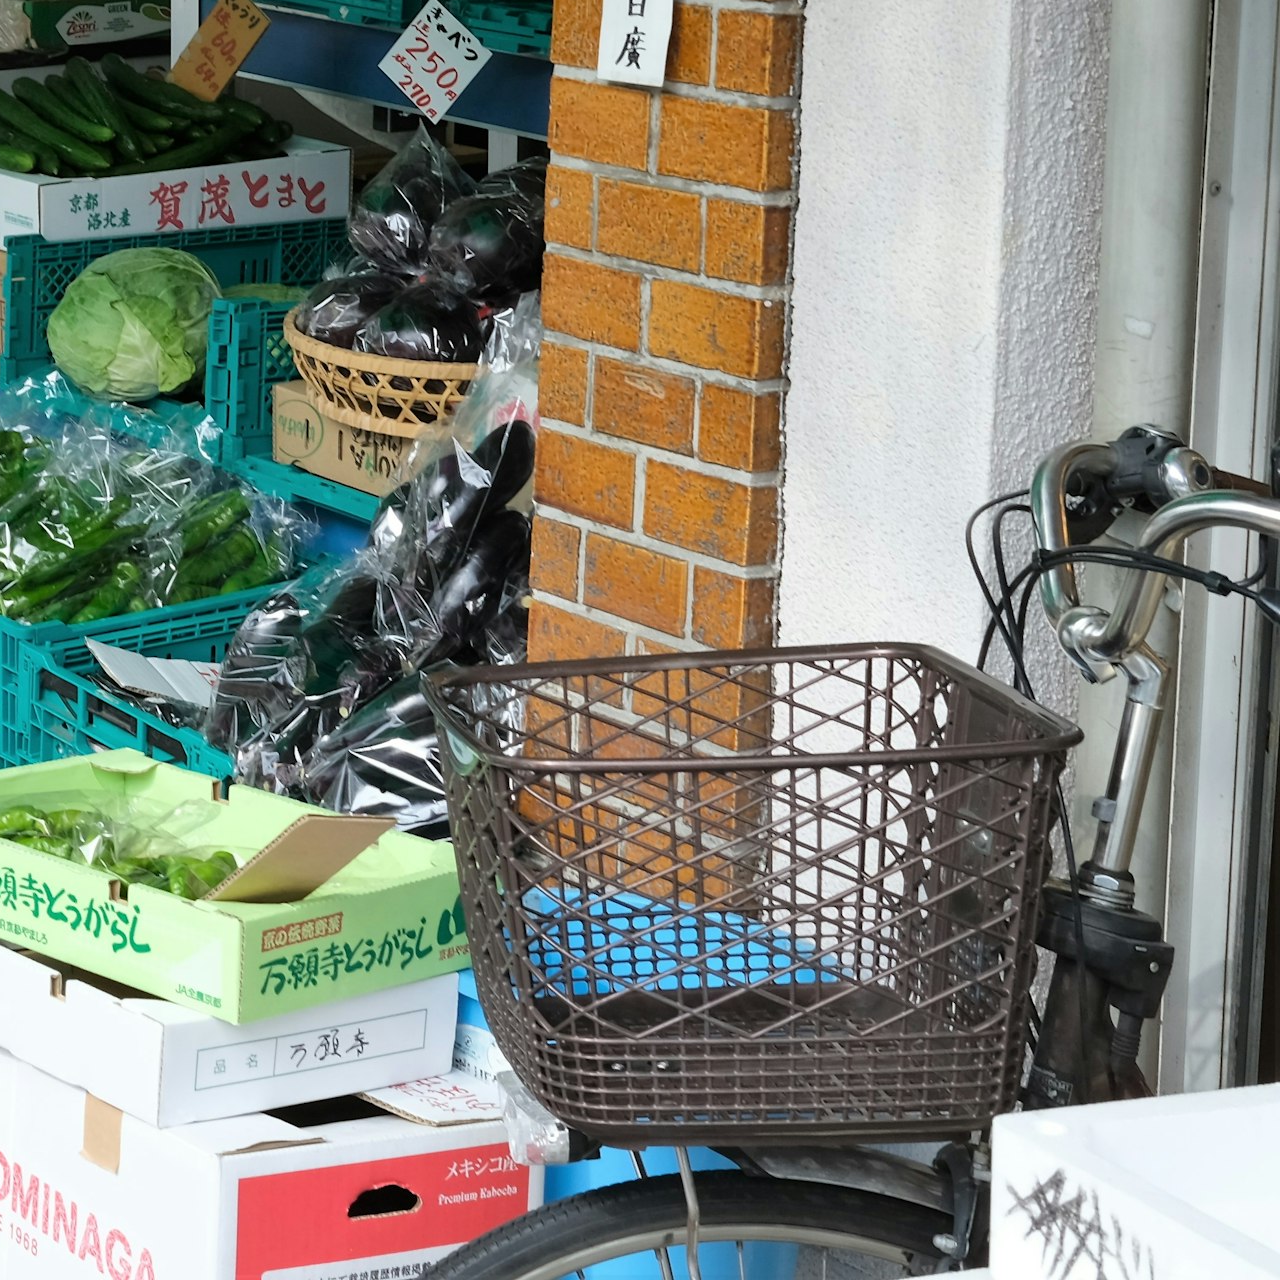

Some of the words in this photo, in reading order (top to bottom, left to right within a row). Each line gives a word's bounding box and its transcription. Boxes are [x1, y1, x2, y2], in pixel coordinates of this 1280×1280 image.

[107, 3, 129, 14] GREEN
[66, 20, 97, 36] Zespri
[427, 7, 479, 62] きゃべつ
[405, 38, 458, 101] 250円
[398, 74, 438, 118] 270円
[69, 193, 99, 215] 京都
[88, 208, 132, 232] 洛北産
[150, 170, 327, 231] 賀茂とまと
[262, 914, 344, 952] 京の伝統野菜
[259, 916, 434, 996] 万願寺とうがらし
[174, 983, 223, 1009] JA全農京都
[437, 1190, 478, 1207] Premium
[9, 1224, 39, 1256] 1968
